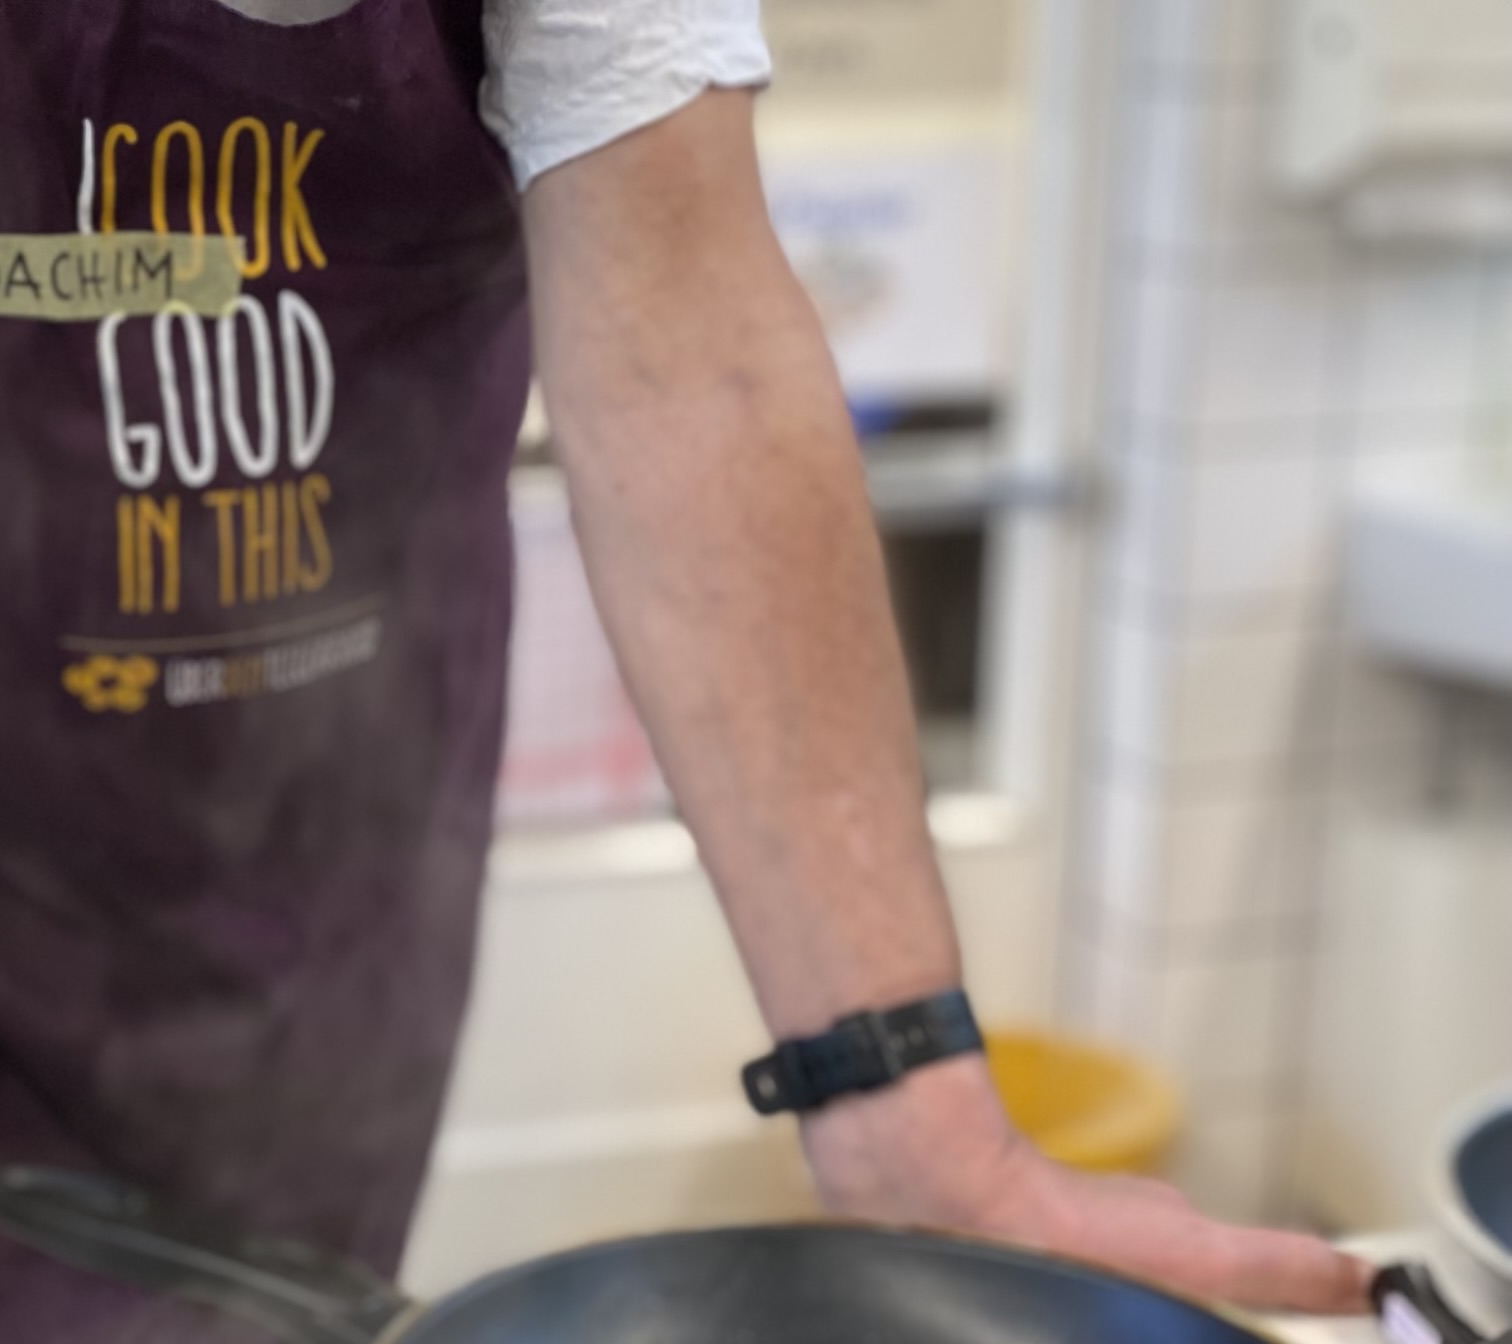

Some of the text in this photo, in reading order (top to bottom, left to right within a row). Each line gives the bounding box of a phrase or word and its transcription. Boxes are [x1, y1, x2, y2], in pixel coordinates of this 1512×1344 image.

[100, 116, 327, 278] COOK
[96, 289, 335, 489] GOOD
[117, 474, 333, 613] IN THIS
